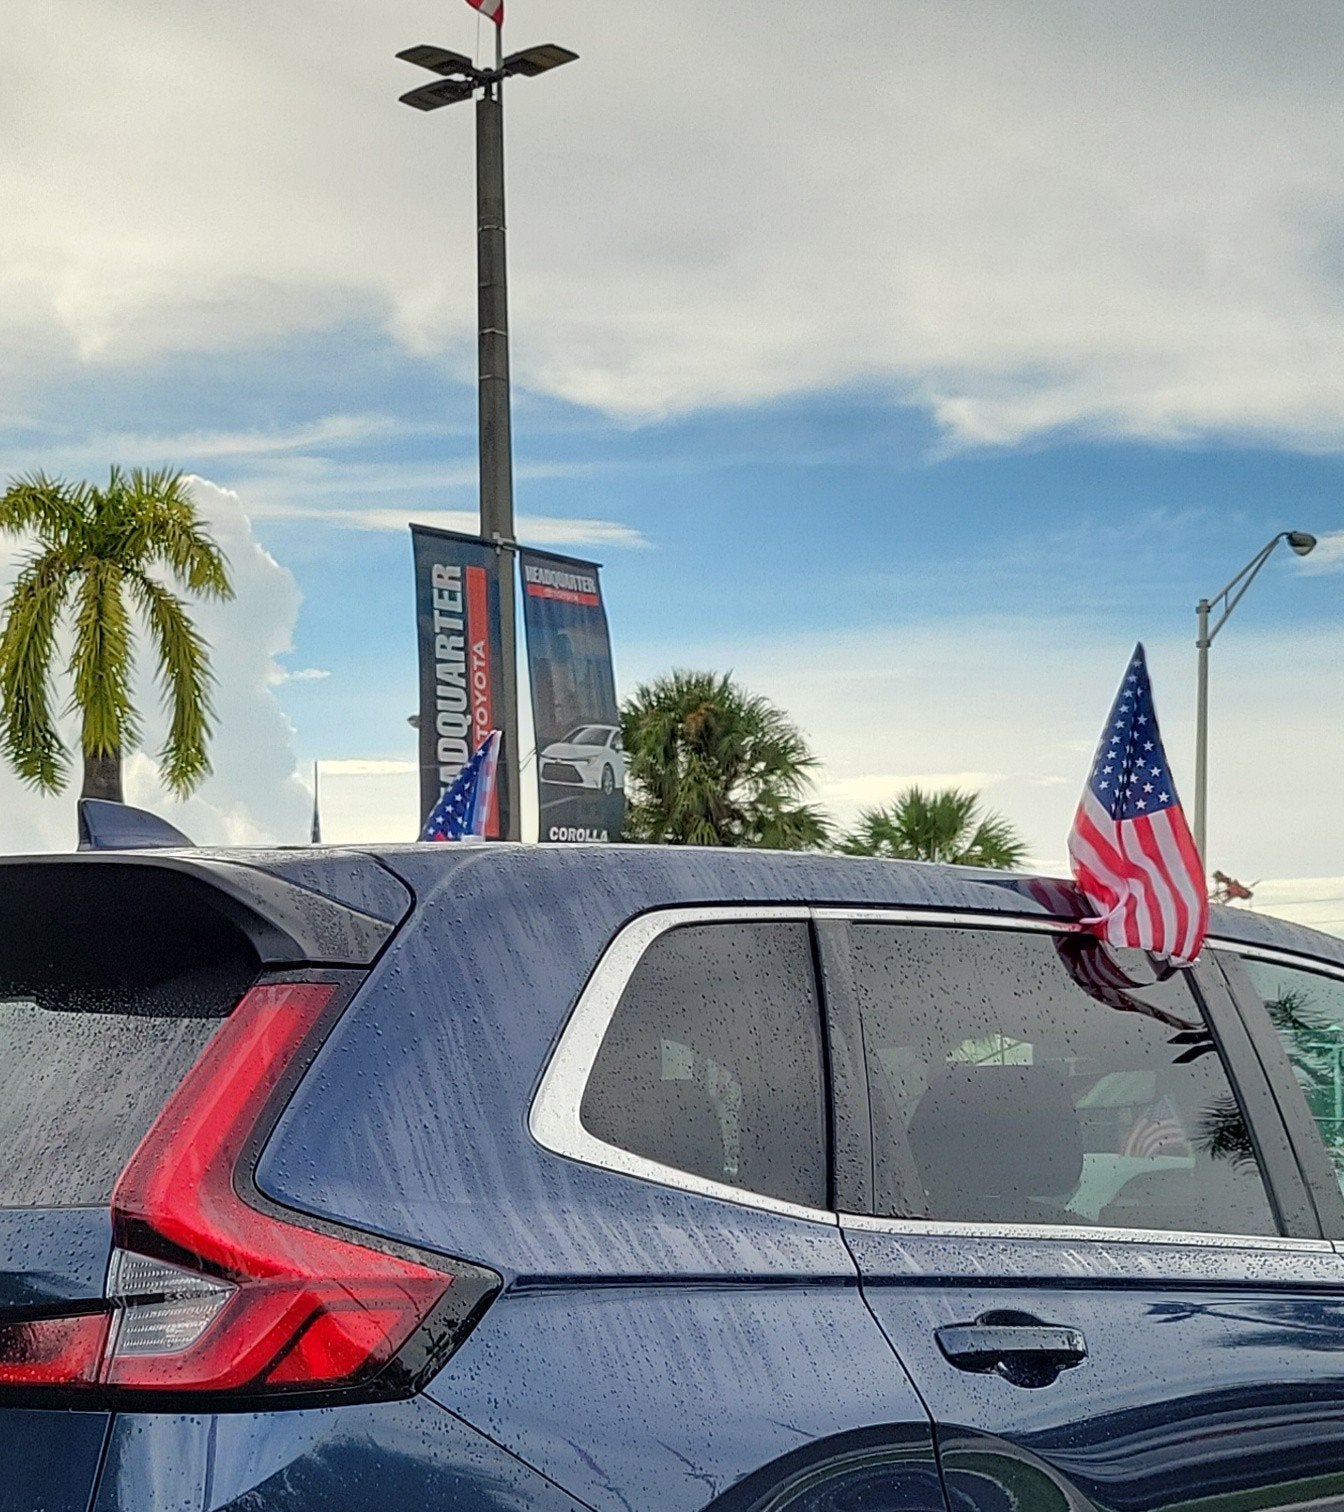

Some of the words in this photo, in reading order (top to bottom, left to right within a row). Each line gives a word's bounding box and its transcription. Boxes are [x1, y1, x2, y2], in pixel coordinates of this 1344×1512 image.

[432, 563, 472, 797] ADQUARTER
[472, 641, 490, 743] TOYOTA
[549, 827, 608, 842] COROLLA
